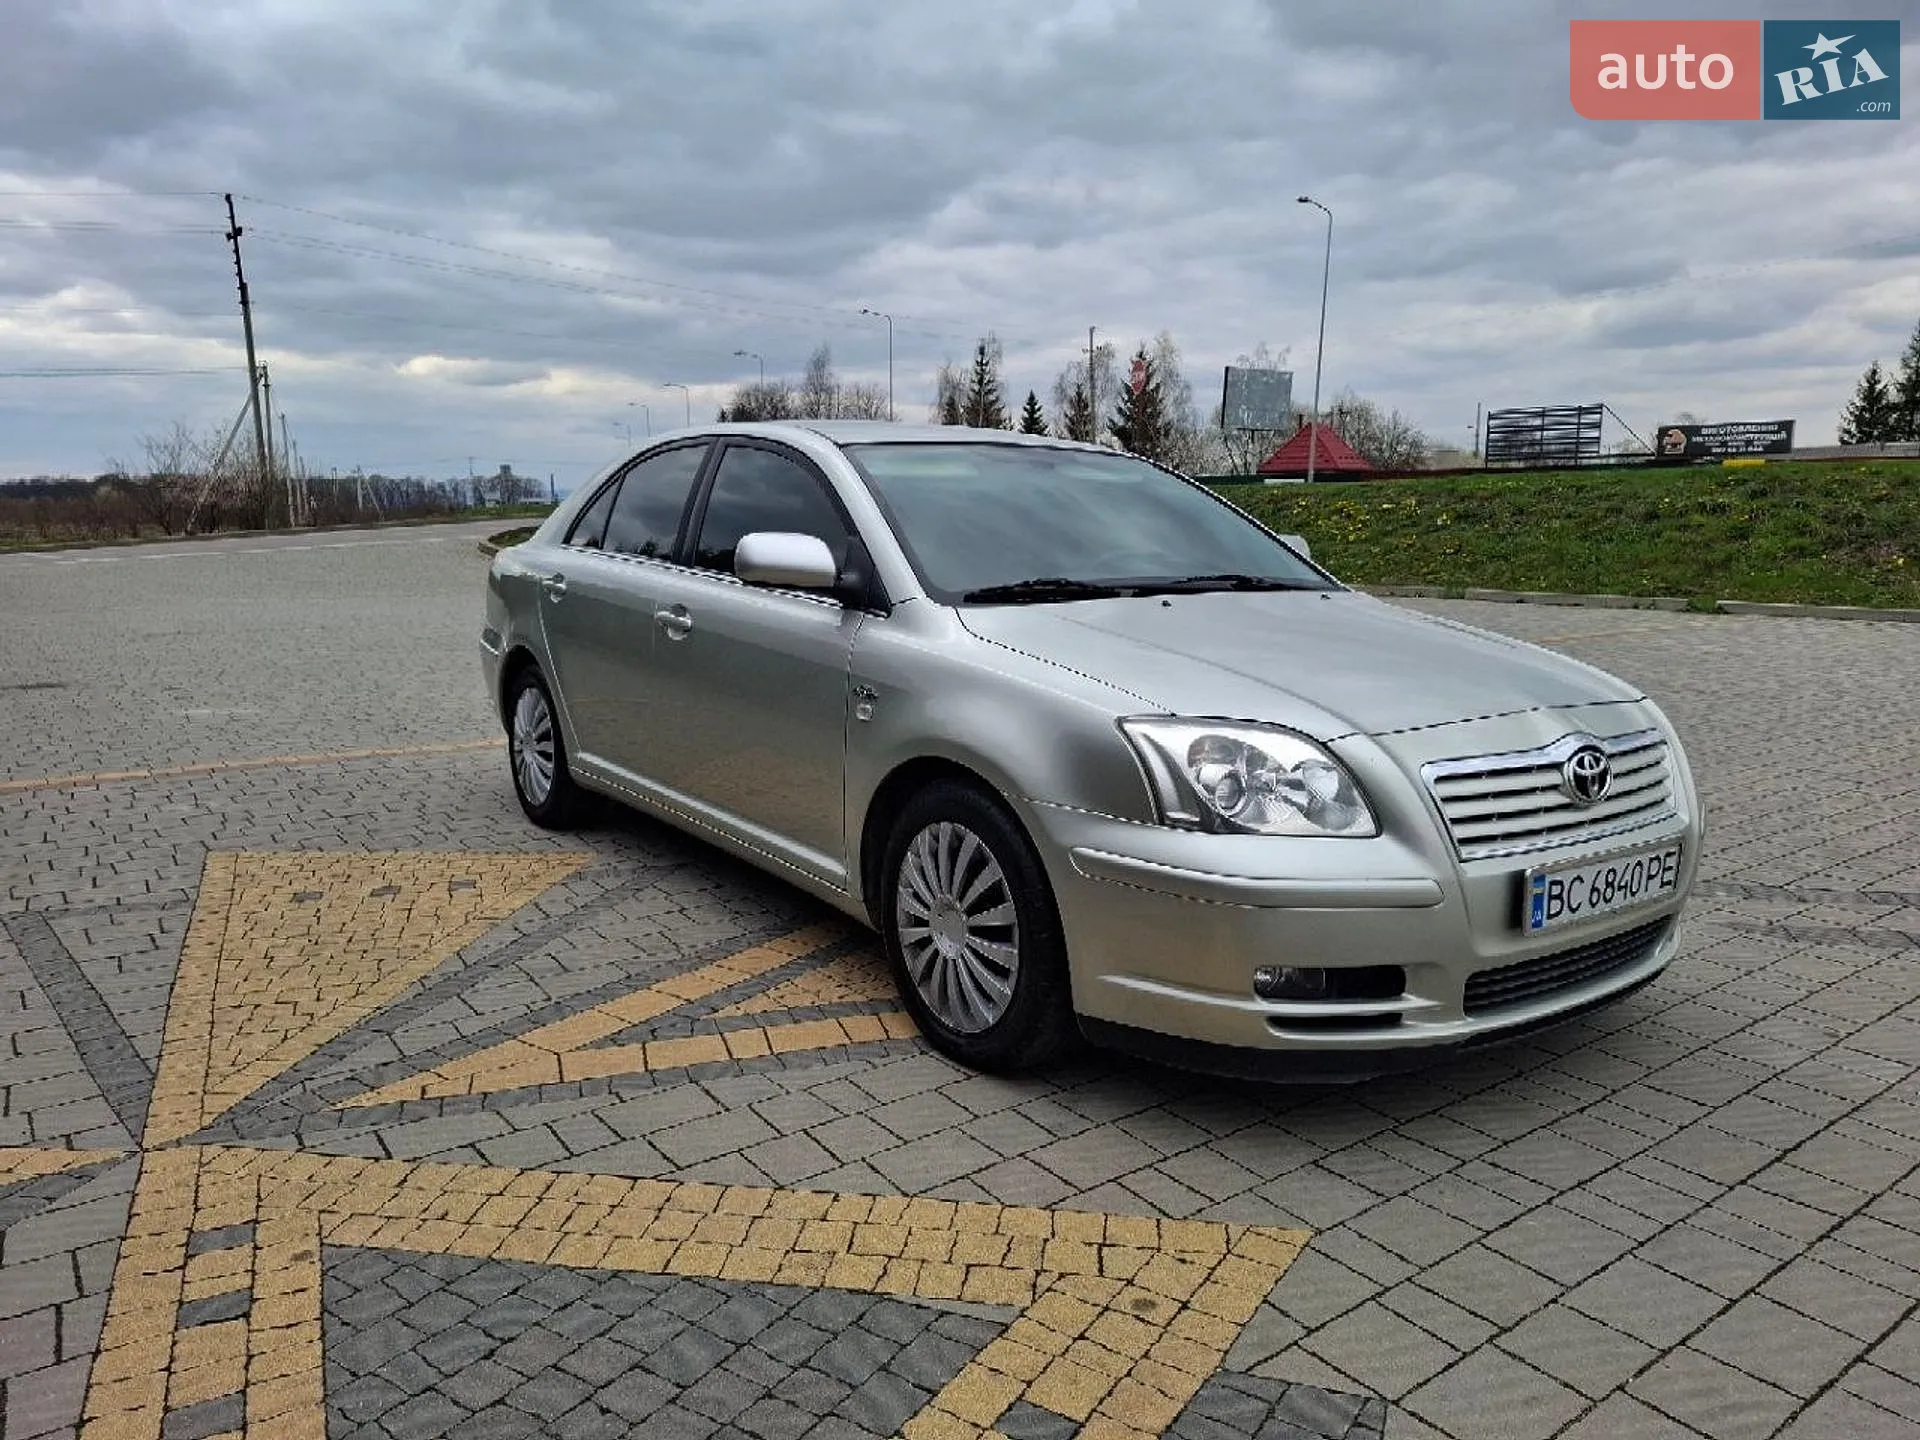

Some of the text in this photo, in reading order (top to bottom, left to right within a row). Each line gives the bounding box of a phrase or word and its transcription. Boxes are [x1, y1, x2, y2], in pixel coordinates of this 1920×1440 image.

[1546, 851, 1677, 920] BC 6840 PE
